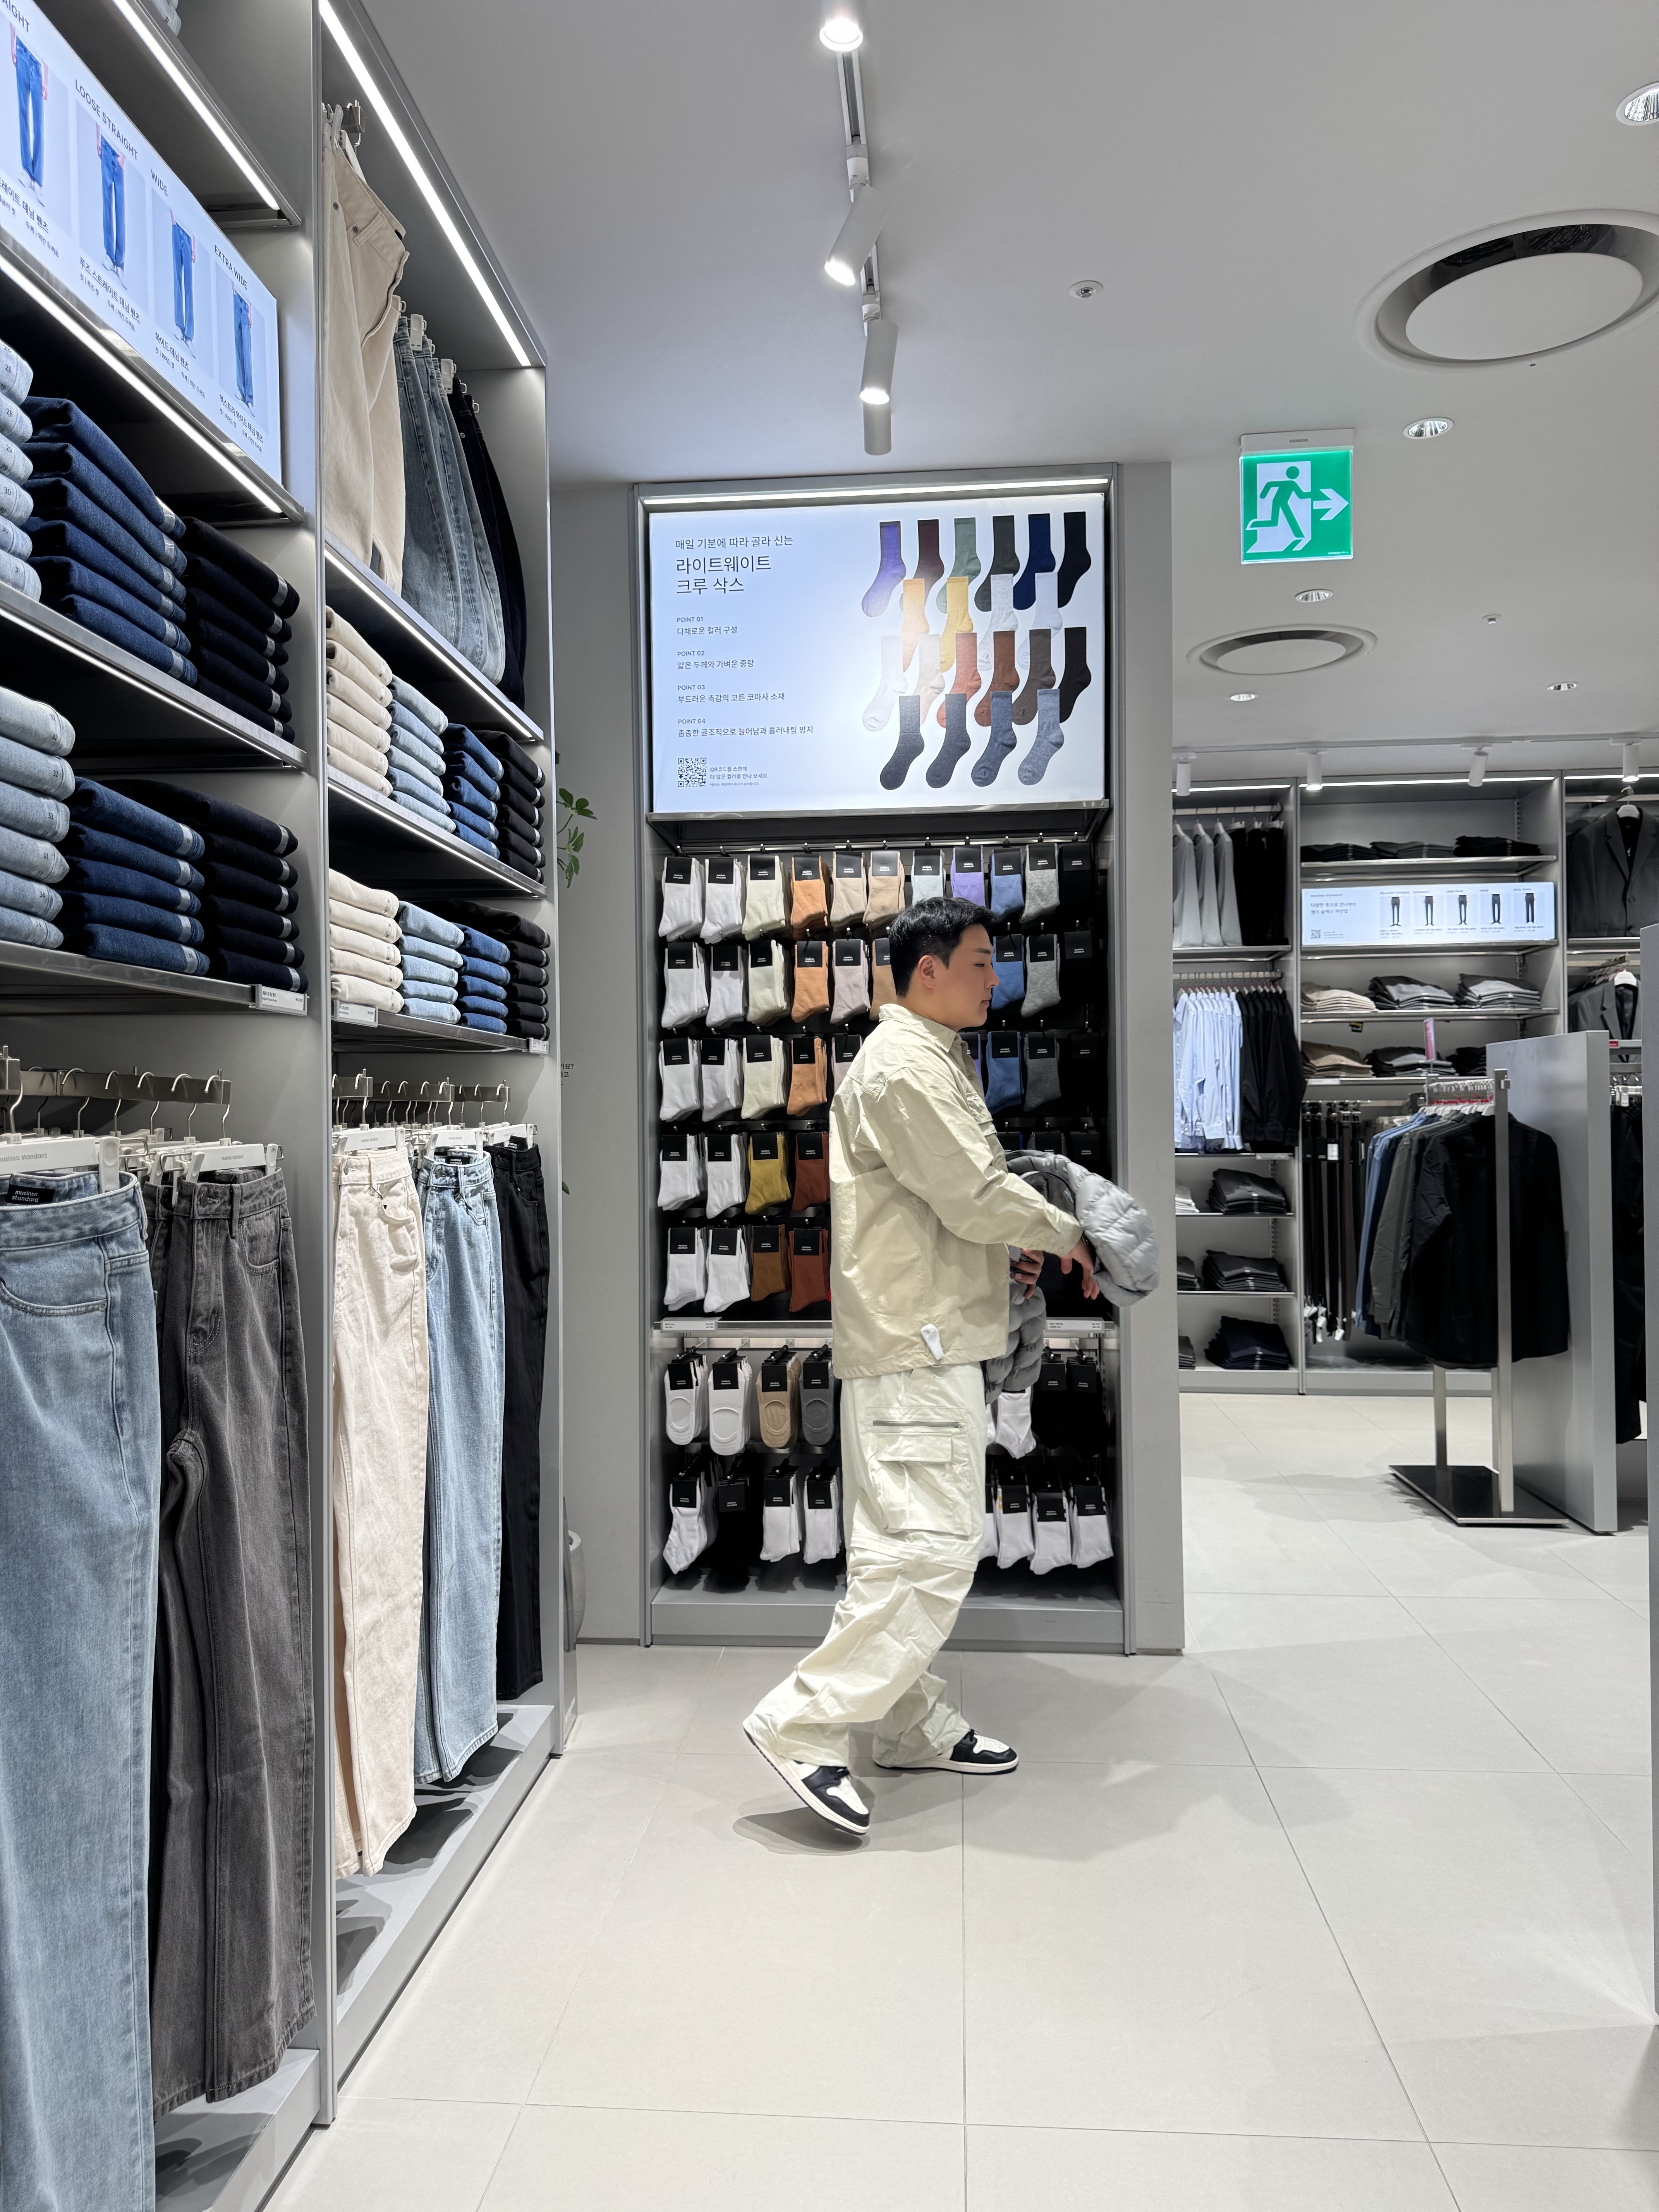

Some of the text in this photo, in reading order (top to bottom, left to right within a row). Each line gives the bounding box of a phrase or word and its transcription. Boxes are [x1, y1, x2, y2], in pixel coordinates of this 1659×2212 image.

[2, 0, 30, 32] AIGHT
[76, 79, 137, 160] LOOSE STRAIGHT
[151, 169, 168, 196] WIDE
[0, 177, 48, 234] 레이트 데님 팬츠
[215, 244, 247, 290] EXTRA WIDE
[80, 257, 141, 324] 루즈 스트레이트 데님 팬츠
[155, 332, 189, 371] 와이드 데님 팬츠
[5, 363, 12, 373] 28
[6, 408, 13, 417] 28
[219, 394, 263, 443] 엑스트라 와이드 데님 팬츠
[6, 444, 12, 453] 29
[5, 486, 11, 496] 30
[2, 525, 9, 534] 30
[675, 535, 793, 550] 매일 기분에 따라 골라 신는
[677, 555, 771, 574] 라이트웨이트
[677, 577, 744, 595] 크루 삭스
[677, 625, 737, 635] 다채로운 컬러 구성
[677, 659, 754, 670] 얇은 두께와 가벼운 중량
[678, 695, 706, 703] 부드러운
[708, 694, 729, 702] 촉감의
[747, 693, 768, 701] 코마사
[701, 728, 737, 737] 골조직으로
[739, 727, 766, 736] 늘어남과
[769, 726, 797, 735] 흘러내림
[799, 725, 813, 734] 방지
